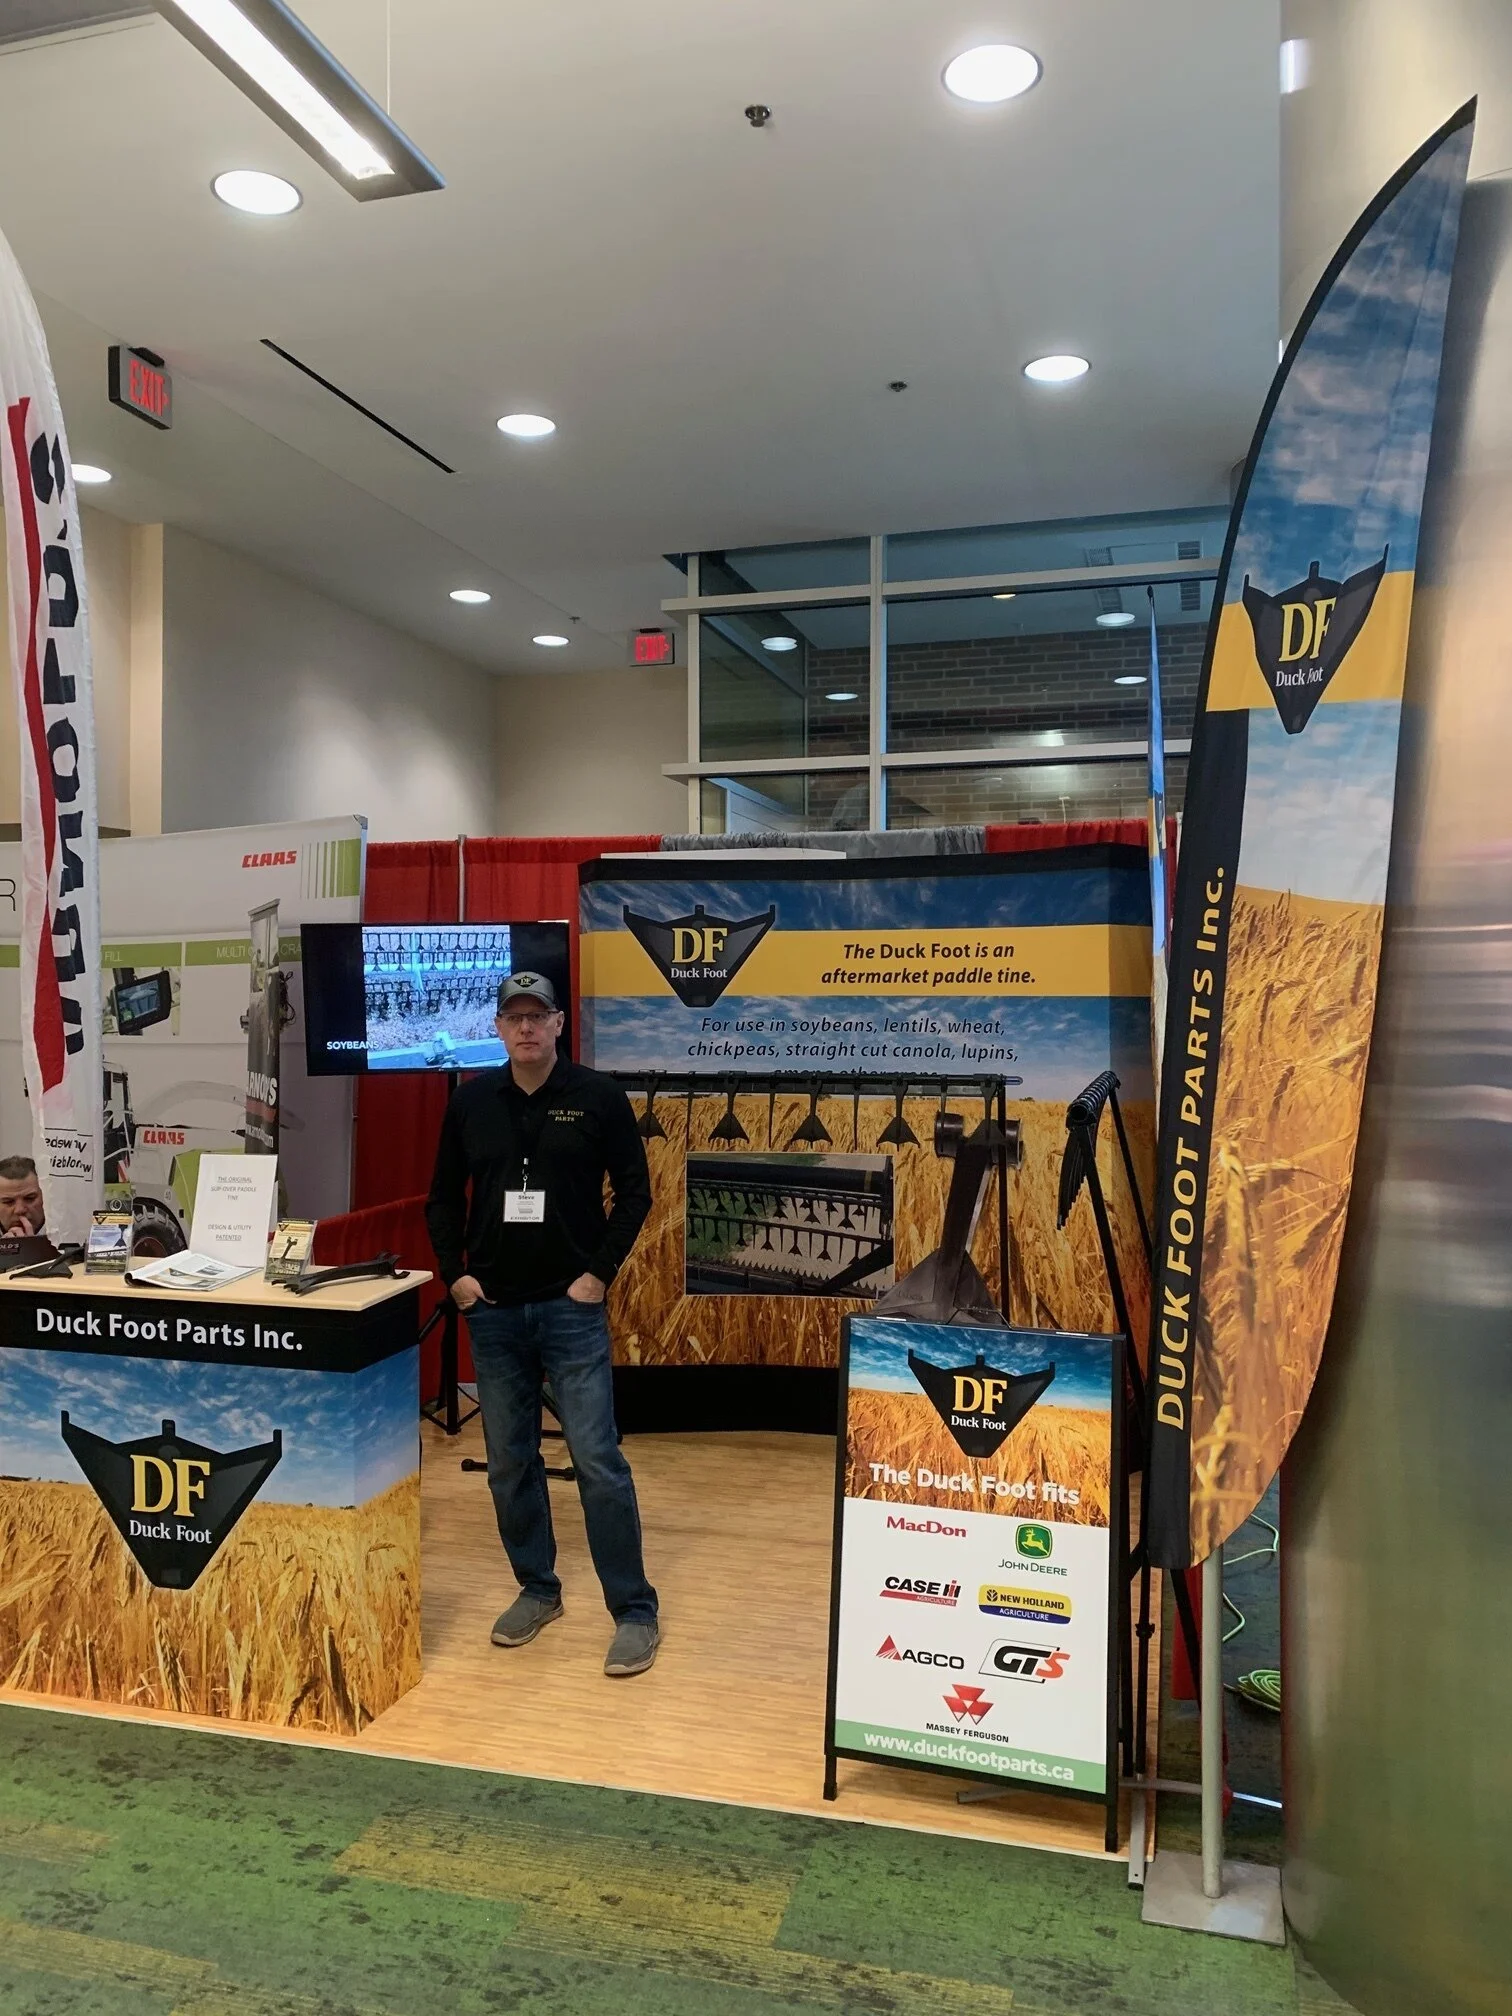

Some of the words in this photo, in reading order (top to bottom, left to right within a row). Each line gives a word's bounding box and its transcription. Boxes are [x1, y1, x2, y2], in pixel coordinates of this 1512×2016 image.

[129, 360, 165, 416] EXIT
[1279, 597, 1337, 661] DF
[1275, 669, 1306, 687] Duck
[242, 850, 297, 868] CLAAS
[1196, 866, 1224, 953] Inc.
[672, 928, 728, 963] DF
[843, 943, 875, 959] The
[880, 943, 926, 959] Duck
[931, 943, 971, 958] Foot
[975, 942, 988, 958] is
[993, 944, 1015, 958] an
[670, 968, 700, 978] Duck
[703, 968, 728, 978] Foot
[821, 968, 930, 984] aftermarket
[932, 968, 992, 987] paddle
[997, 969, 1036, 983] tine.
[701, 1017, 730, 1031] For
[735, 1020, 765, 1032] use
[769, 1018, 785, 1031] in
[791, 1017, 878, 1036] soybeans,
[884, 1018, 942, 1035] lentils,
[948, 1018, 1005, 1035] wheat,
[326, 1040, 379, 1050] SOYBEANS
[688, 1041, 780, 1060] chickpeas,
[785, 1042, 856, 1060] straight
[861, 1044, 892, 1057] cut
[892, 1043, 956, 1060] canola,
[961, 1043, 1019, 1062] lupins,
[1180, 968, 1214, 1126] PARTS
[143, 1130, 184, 1145] CLAAS
[1166, 1137, 1200, 1277] FOOT
[36, 1308, 102, 1336] Duck
[109, 1313, 168, 1341] Foot
[176, 1318, 246, 1347] Parts
[253, 1324, 303, 1351] Inc.
[1157, 1285, 1191, 1430] DUCK
[952, 1375, 1008, 1415] DF
[950, 1414, 980, 1429] Duck
[982, 1418, 1007, 1431] Foot
[130, 1454, 211, 1517] DF
[869, 1462, 911, 1486] The
[917, 1468, 975, 1493] Duck
[982, 1475, 1037, 1499] Foot
[1041, 1480, 1080, 1505] fits
[129, 1519, 171, 1540] Duck
[176, 1524, 212, 1544] Foot
[886, 1515, 967, 1538] MacDon
[998, 1559, 1029, 1571] JOHN
[1030, 1562, 1068, 1576] DEERE
[885, 1576, 942, 1594] CASE
[916, 1595, 956, 1606] AGRICULTURE
[1000, 1593, 1021, 1603] NEW
[1023, 1596, 1065, 1610] HOLLAND
[999, 1608, 1049, 1621] AGRICULTURE
[902, 1649, 965, 1670] AGCO
[993, 1645, 1071, 1679] GTS
[926, 1722, 961, 1735] MASSEY
[963, 1728, 1009, 1743] FERGUSON
[864, 1732, 1075, 1781] www.duckfootparts.ca
